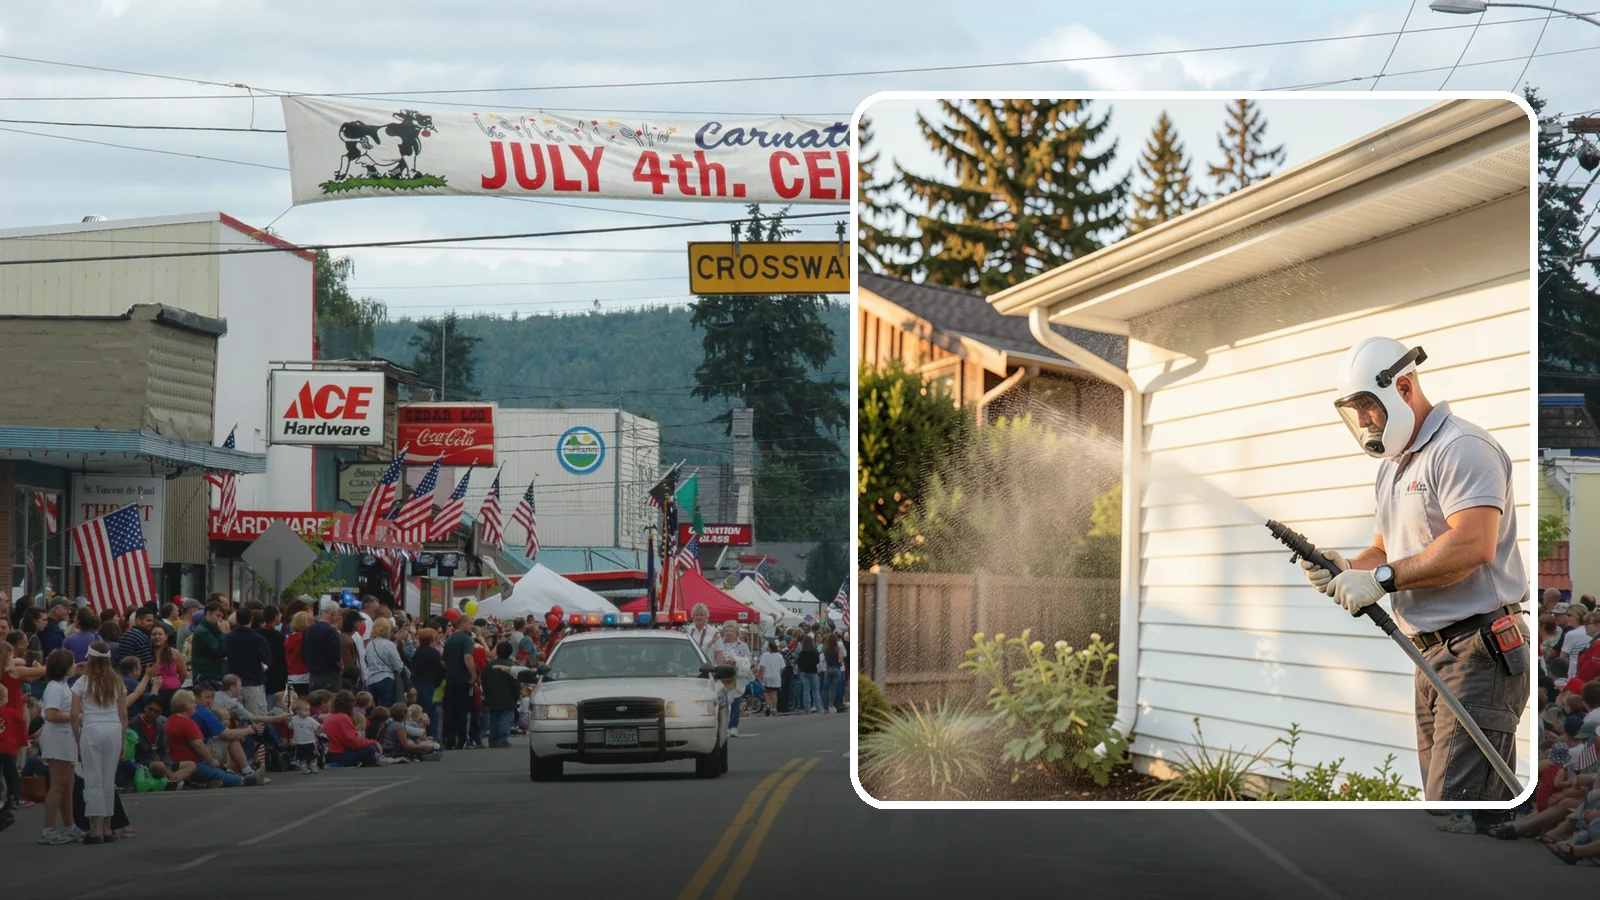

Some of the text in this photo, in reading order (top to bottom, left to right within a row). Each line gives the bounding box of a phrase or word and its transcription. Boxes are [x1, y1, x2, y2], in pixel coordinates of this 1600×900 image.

[695, 121, 850, 150] Carnat
[481, 141, 604, 192] JULY
[632, 150, 746, 197] 4th.
[696, 254, 850, 281] CROSSWA
[282, 380, 373, 420] ACE
[405, 409, 485, 422] CEDAR LOG
[283, 421, 371, 436] Hardware
[416, 428, 477, 447] Coca-Cola
[353, 467, 386, 480] Simpl
[96, 485, 124, 494] Vincent
[126, 486, 135, 494] de
[137, 486, 155, 495] Paul
[212, 516, 331, 536] HARDARE
[688, 526, 741, 535] CRNATION
[699, 535, 730, 543] GLASS
